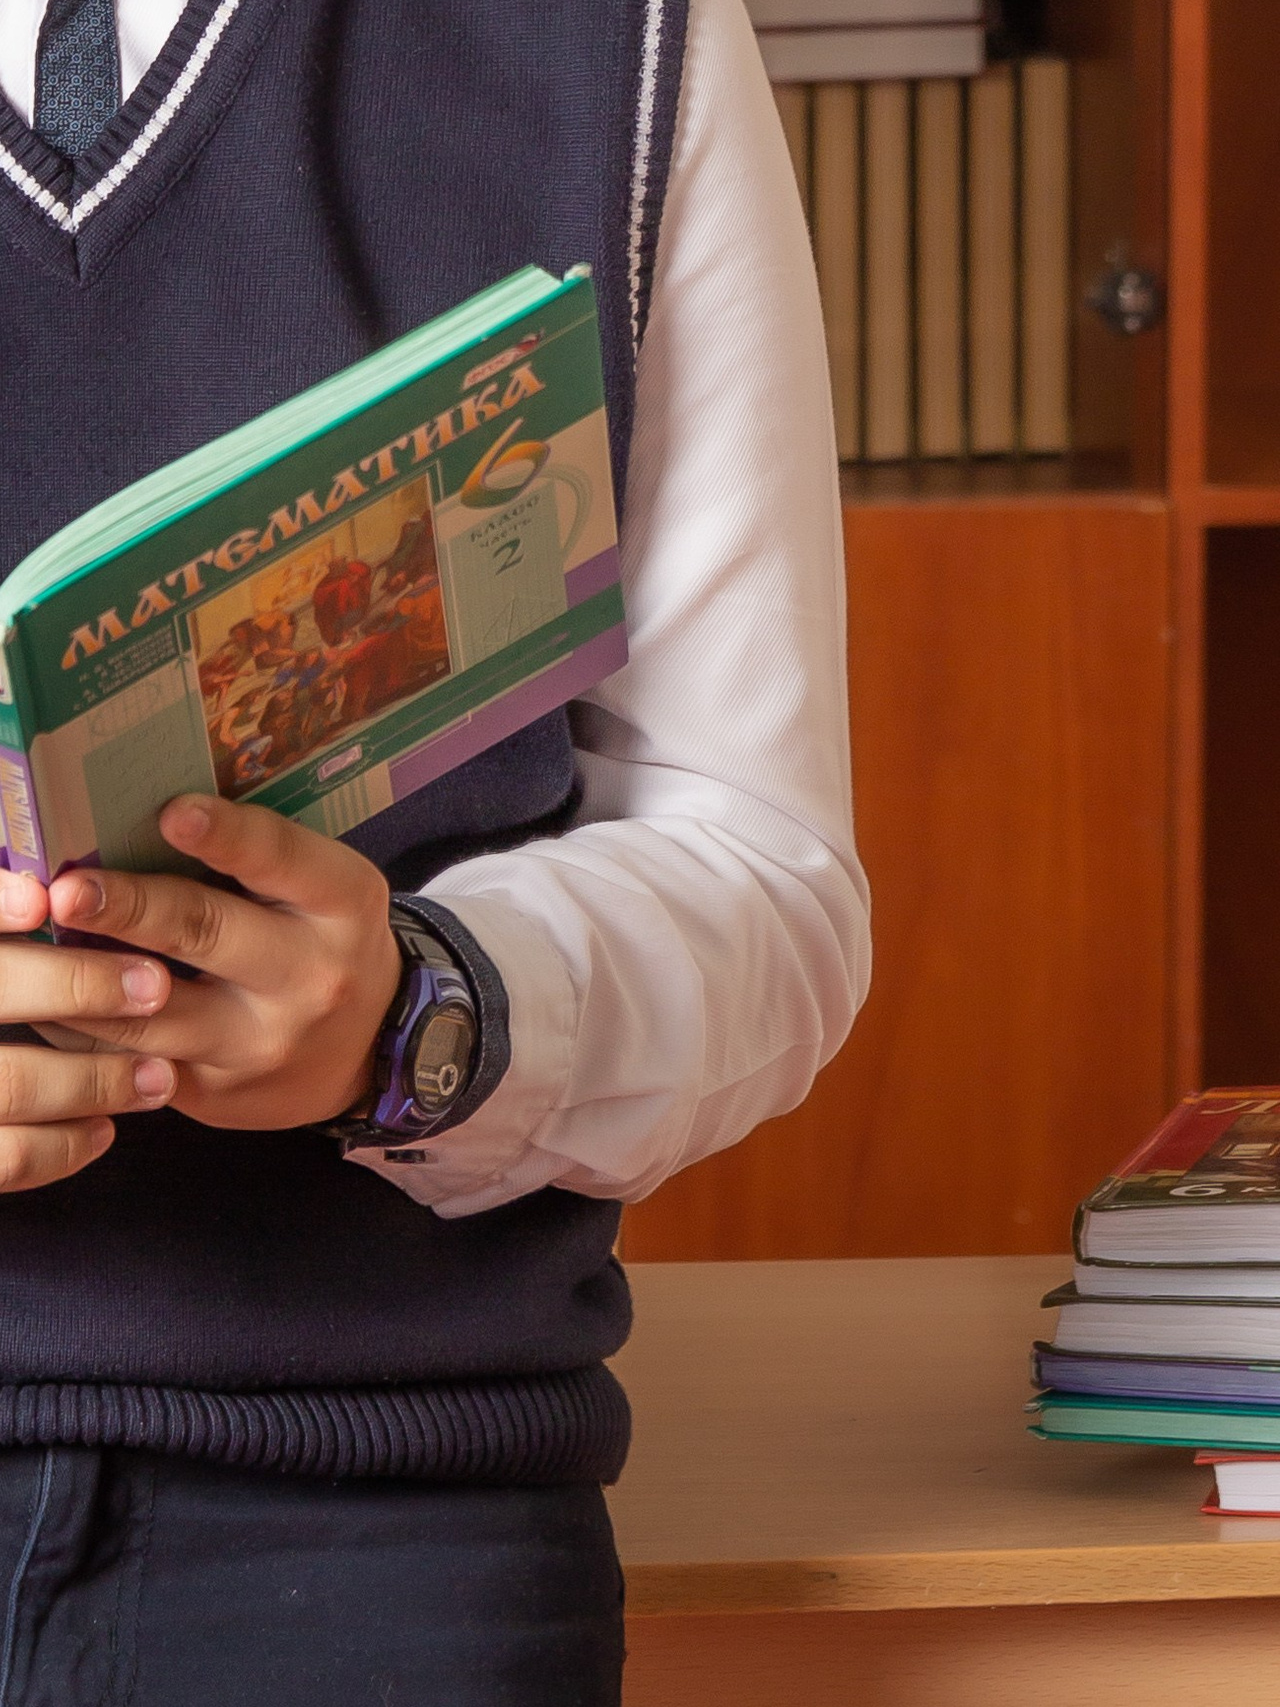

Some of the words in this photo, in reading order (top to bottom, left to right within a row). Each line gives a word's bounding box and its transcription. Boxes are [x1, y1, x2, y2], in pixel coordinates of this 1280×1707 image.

[461, 418, 551, 509] 6
[60, 361, 547, 670] МАТЕМАТИКА
[493, 539, 524, 575] 2
[1169, 1183, 1227, 1197] 6
